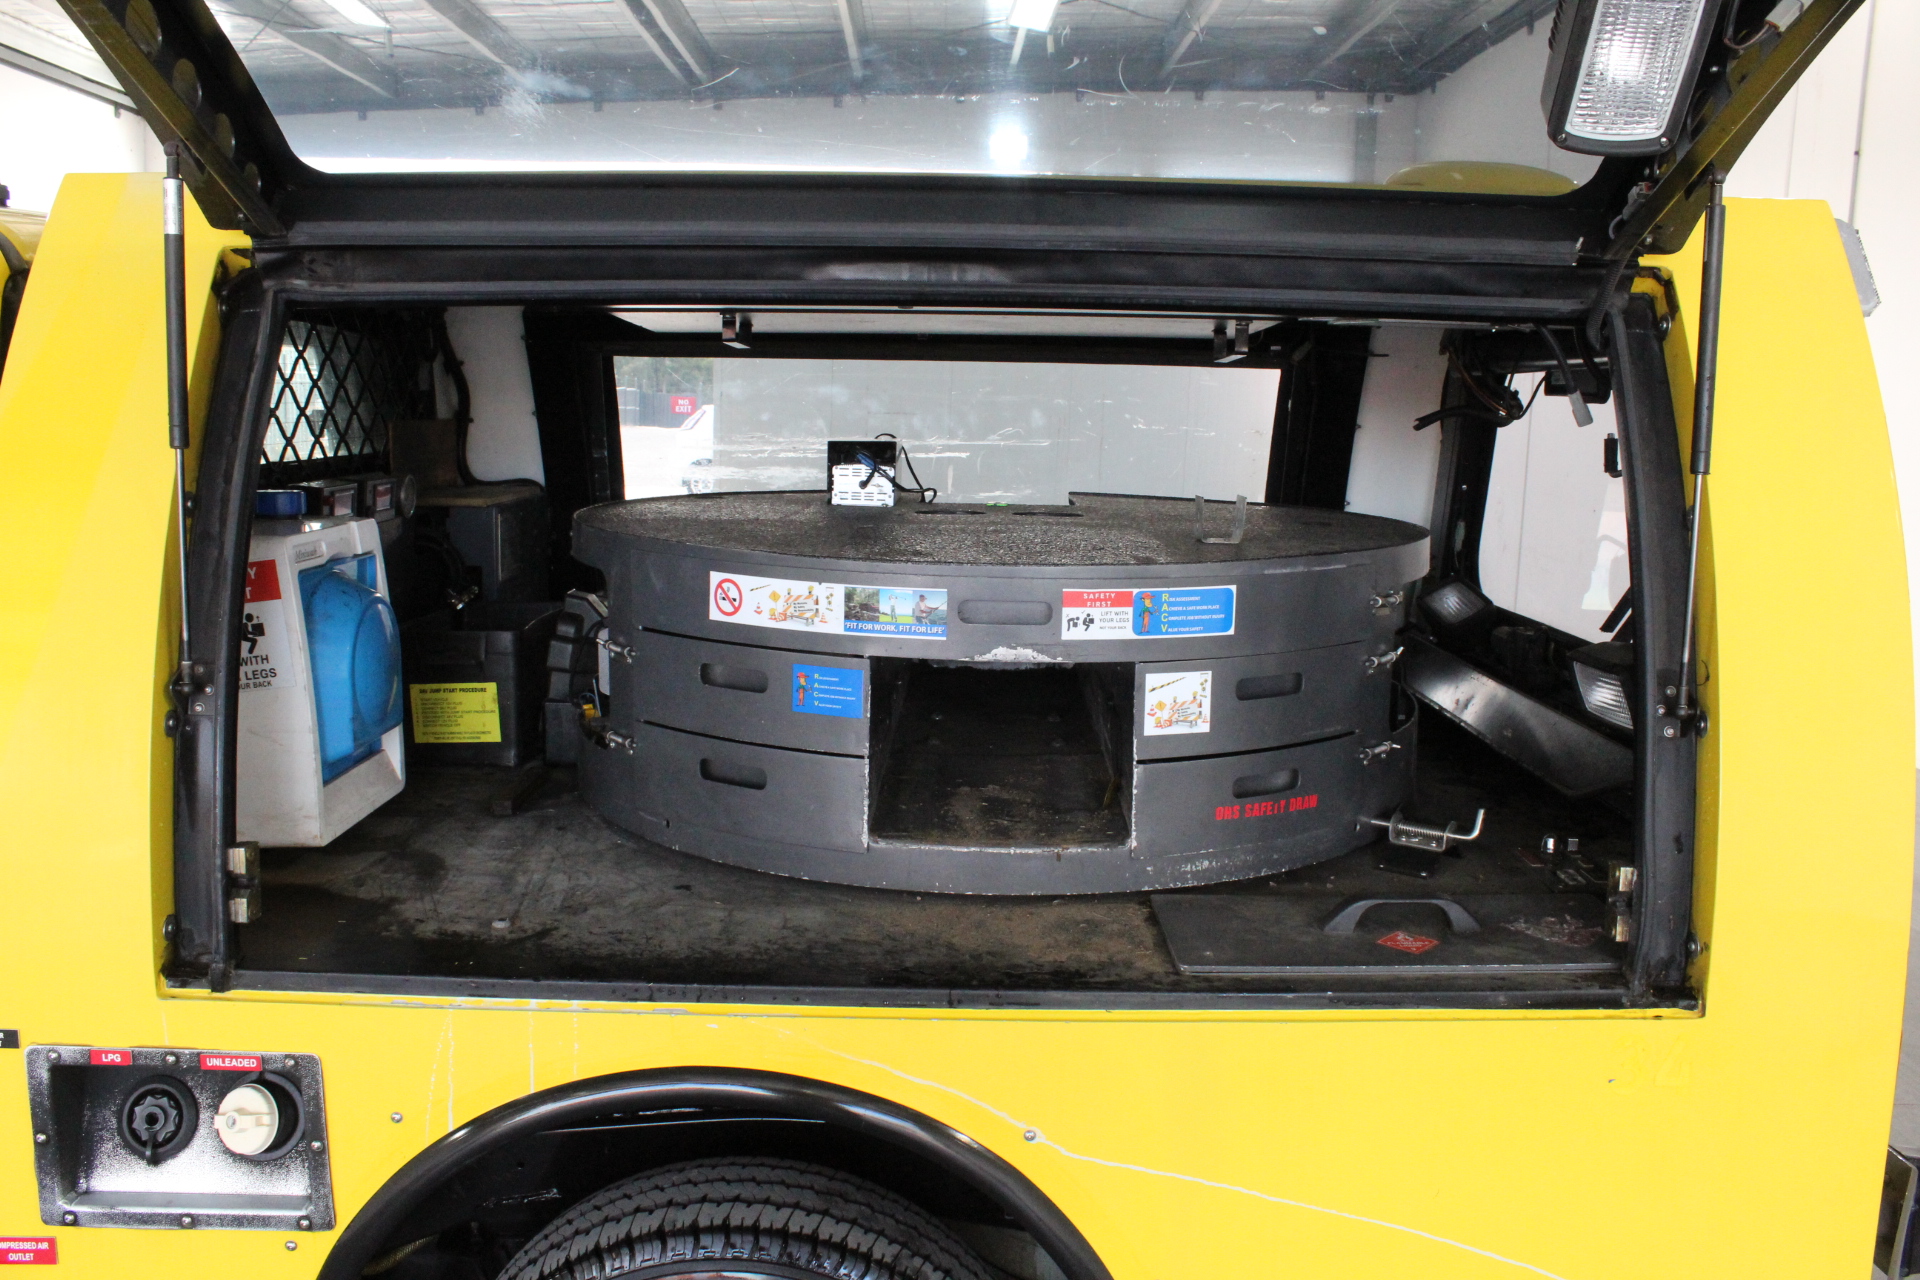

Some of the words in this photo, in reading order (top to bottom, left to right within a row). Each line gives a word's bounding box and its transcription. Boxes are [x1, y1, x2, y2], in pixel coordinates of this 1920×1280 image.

[874, 624, 898, 632] WORK,
[245, 668, 277, 680] LEGS
[253, 680, 272, 688] BACK
[1289, 794, 1319, 812] DRAW
[102, 1053, 121, 1062] LPG
[206, 1058, 257, 1067] UNLEADED
